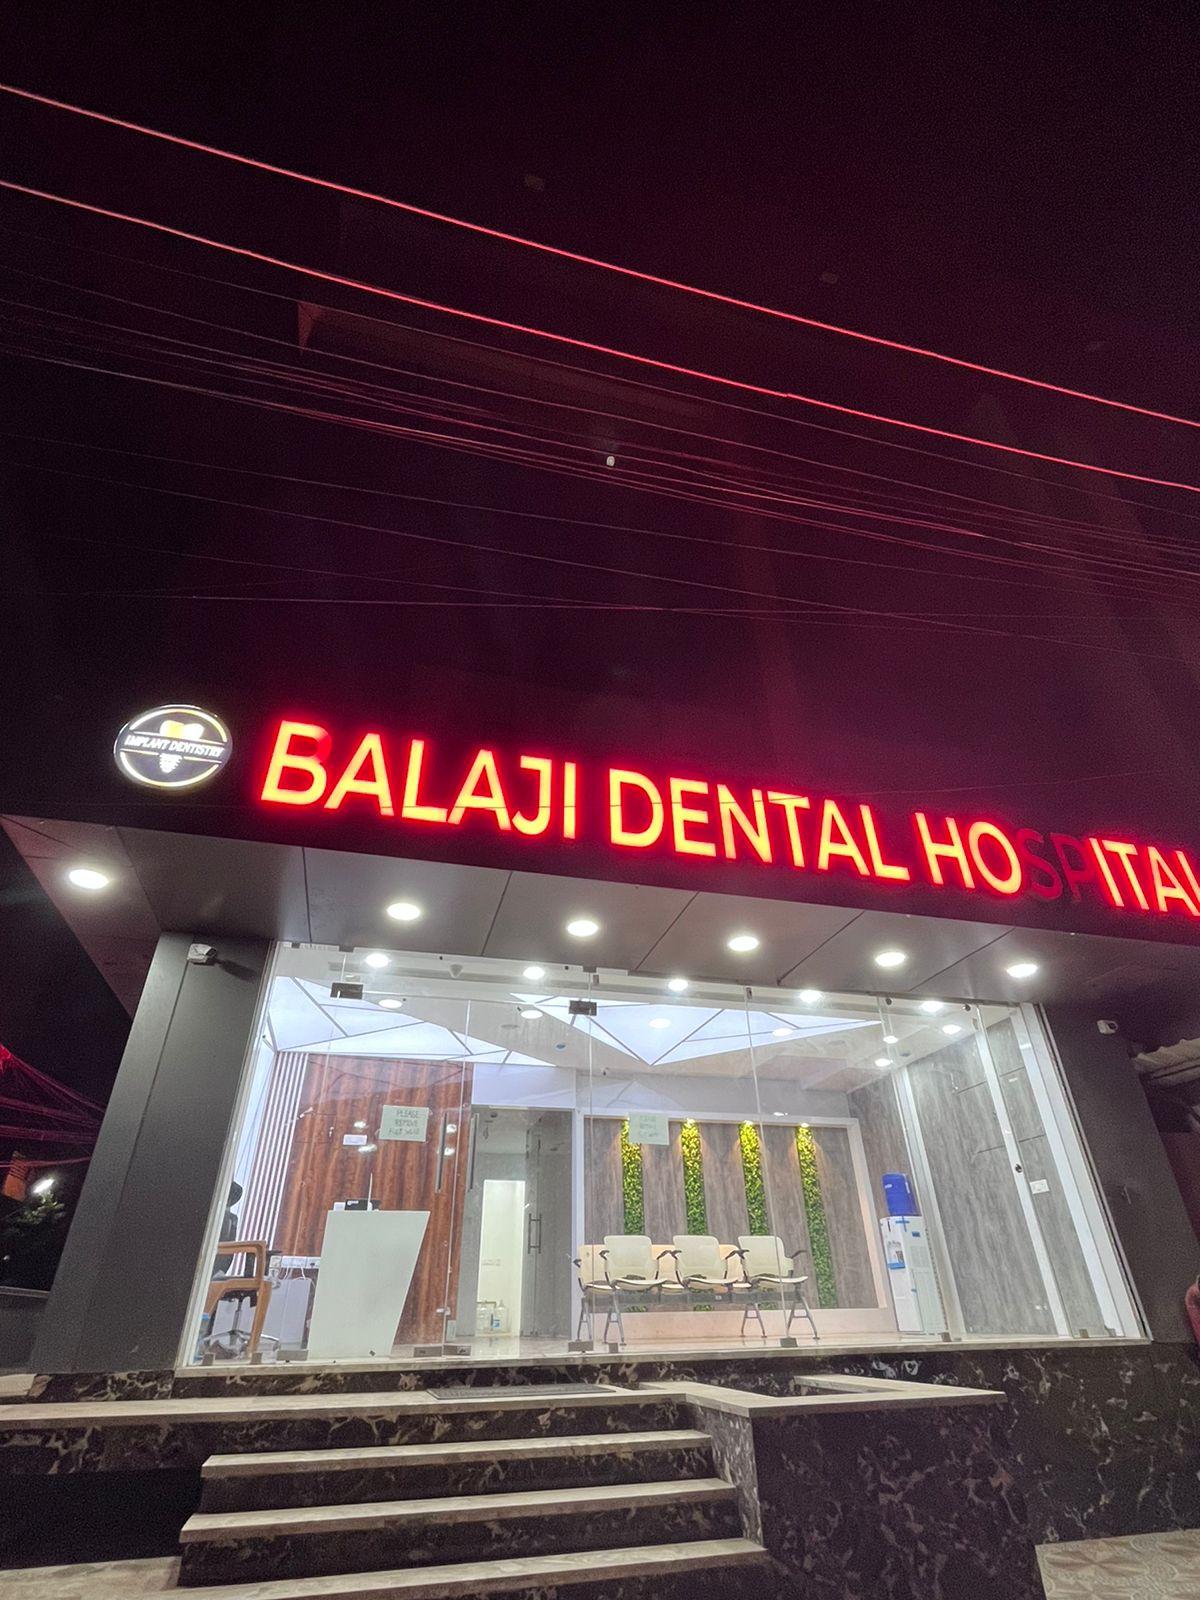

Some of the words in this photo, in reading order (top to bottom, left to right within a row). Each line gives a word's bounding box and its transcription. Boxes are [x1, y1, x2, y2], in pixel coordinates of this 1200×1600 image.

[124, 735, 169, 750] IMPLANT
[168, 742, 225, 757] DENTISTRY
[261, 720, 575, 839] BALAJI
[610, 768, 909, 880] DENTAL
